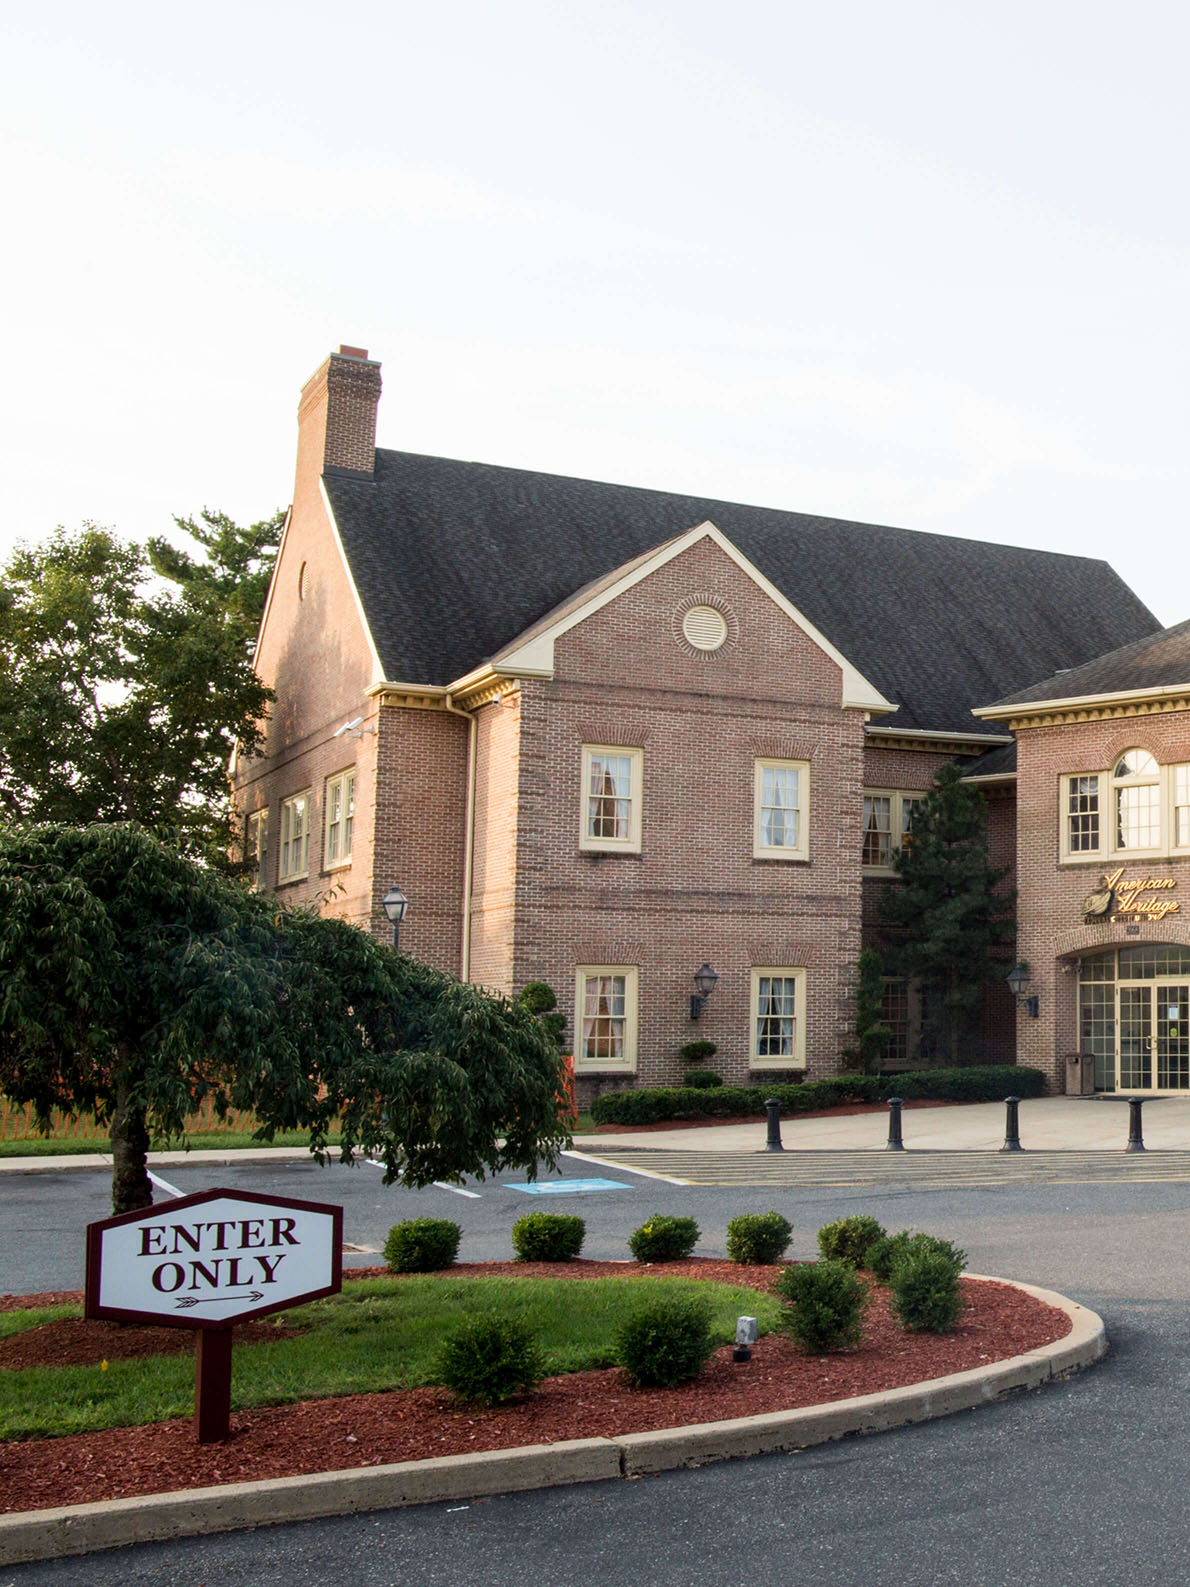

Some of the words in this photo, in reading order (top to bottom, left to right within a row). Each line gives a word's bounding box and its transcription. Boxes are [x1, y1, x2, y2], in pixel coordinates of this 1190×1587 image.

[1105, 868, 1177, 891] American
[1118, 889, 1180, 920] Heritage
[137, 1217, 301, 1256] ENTER
[152, 1254, 286, 1293] ONLY
